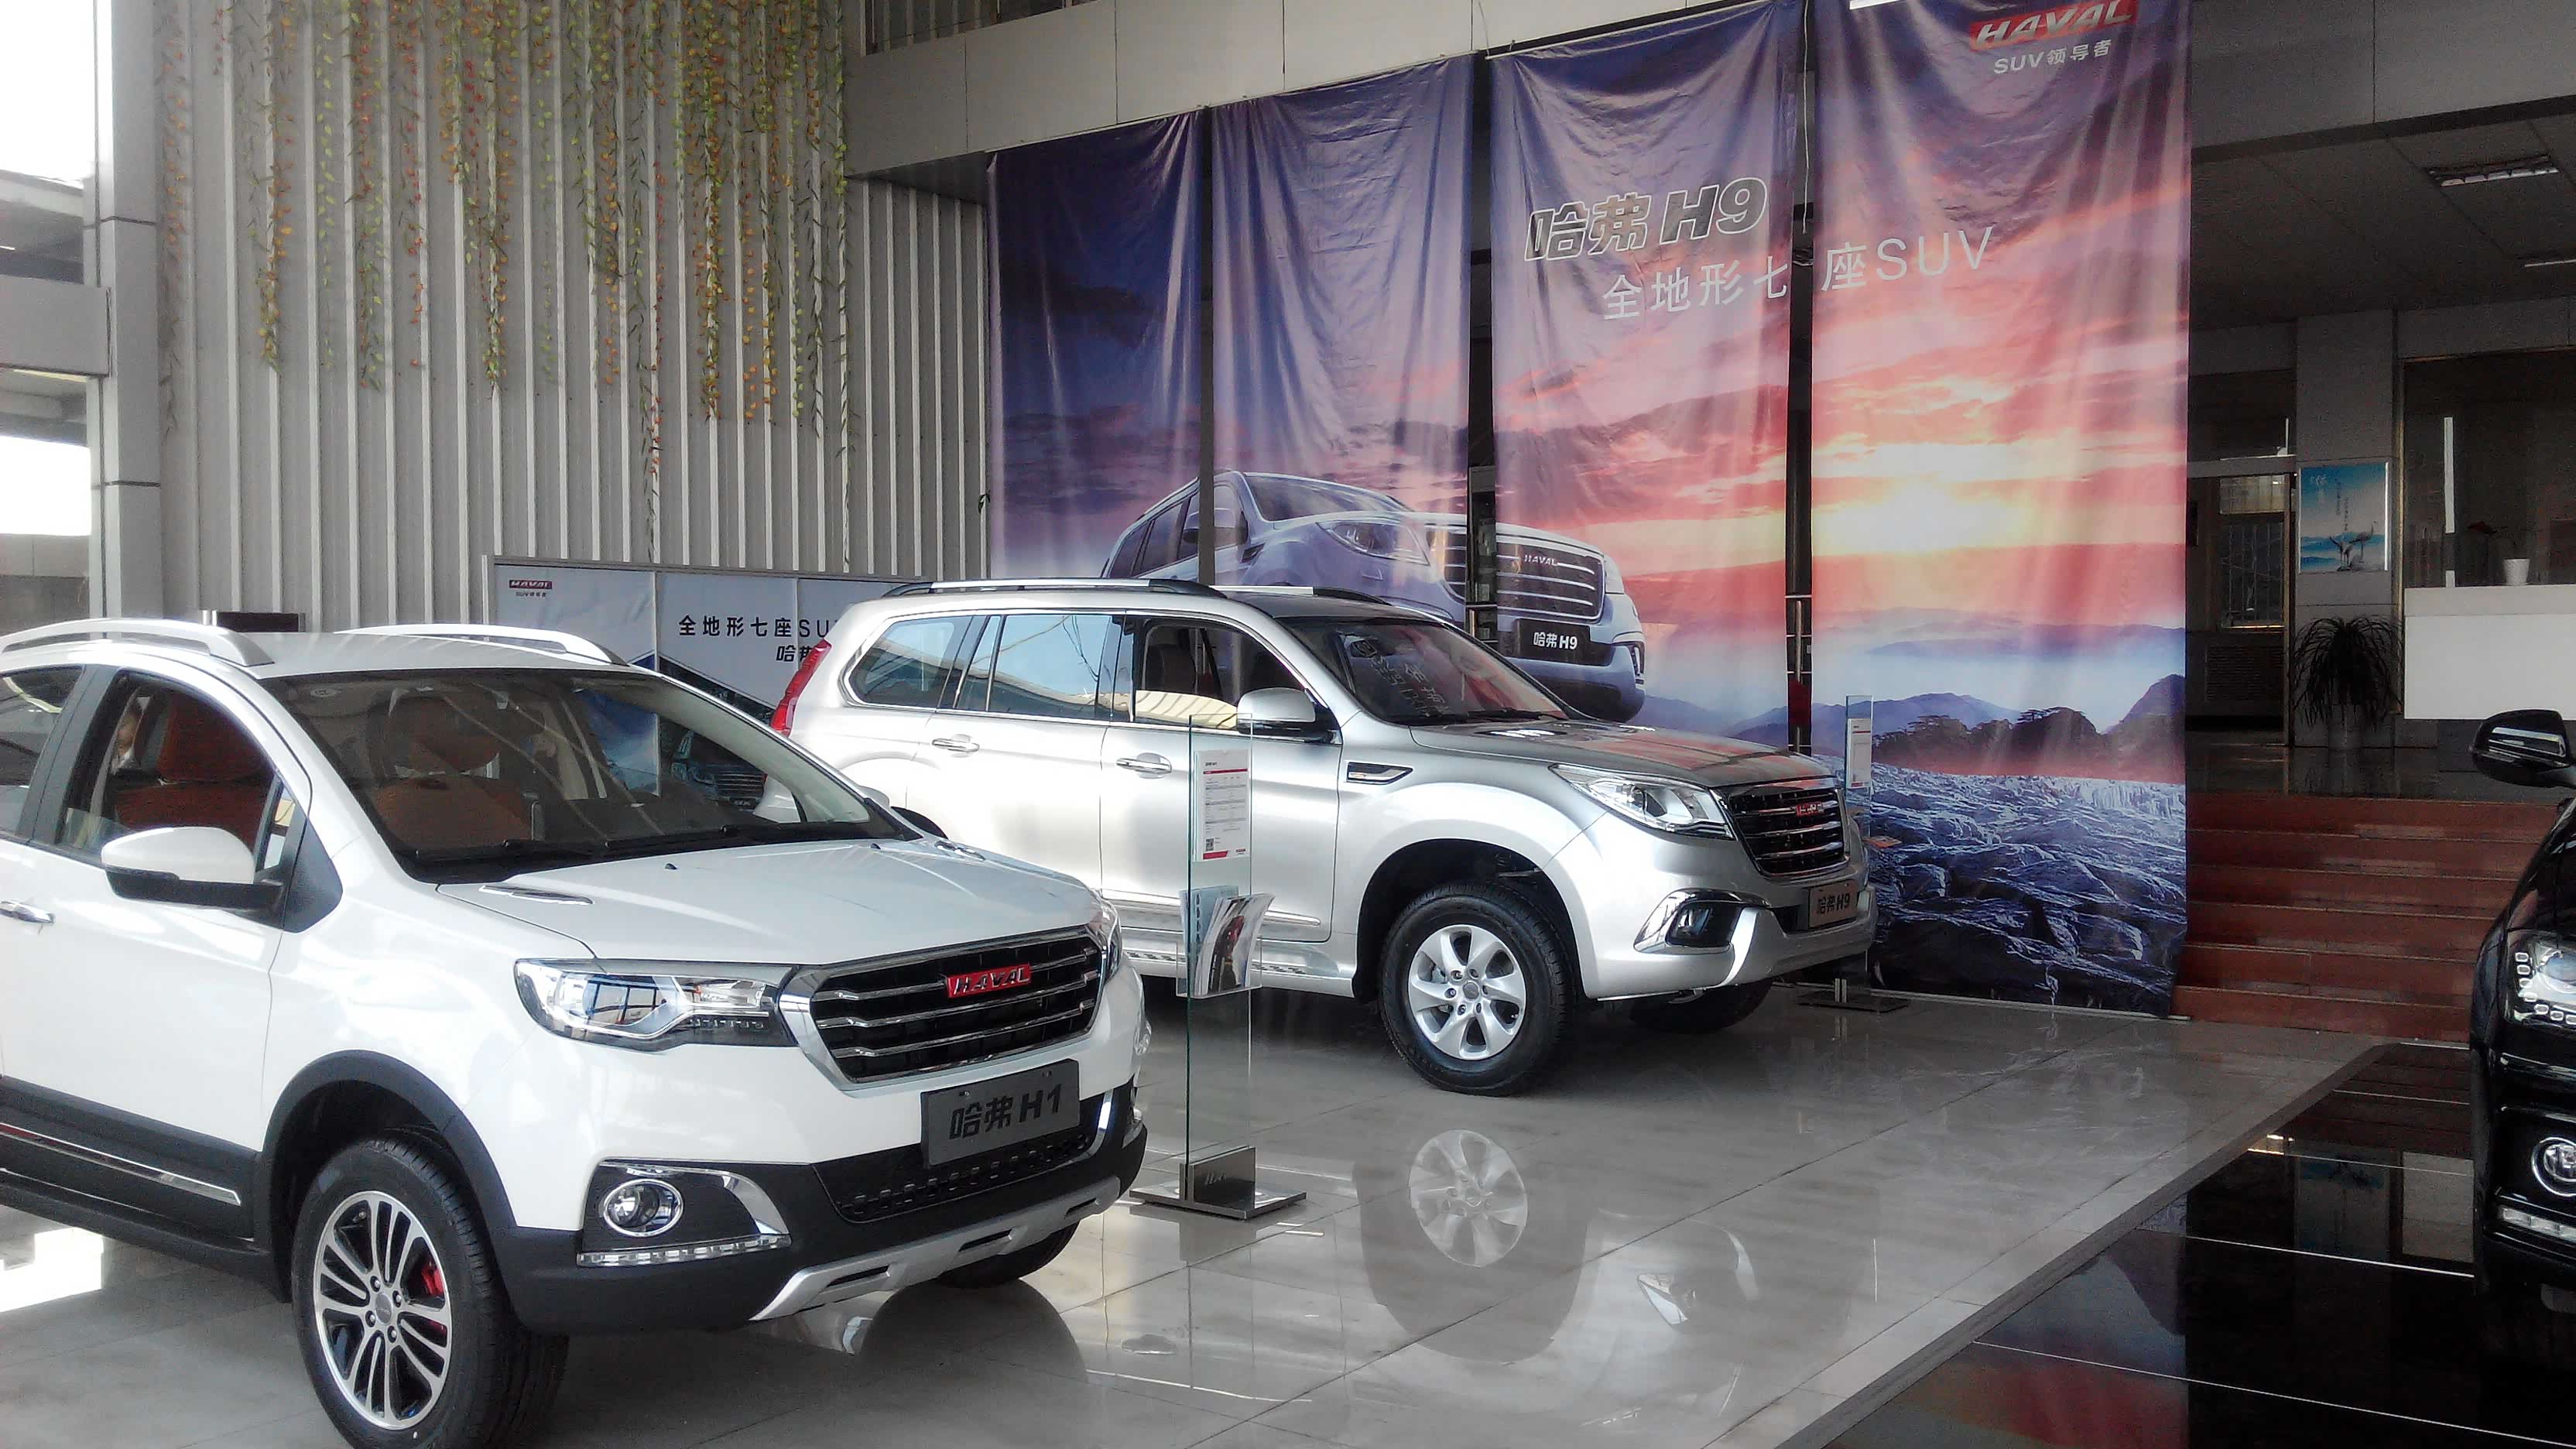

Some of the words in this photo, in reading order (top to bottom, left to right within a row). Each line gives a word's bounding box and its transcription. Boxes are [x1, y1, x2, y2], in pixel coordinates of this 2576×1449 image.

[1975, 0, 2132, 46] HAVAL
[1993, 39, 2112, 74] SUV领导者
[1524, 192, 1652, 262] 哈弗
[1659, 176, 1768, 245] H9
[679, 615, 838, 638] 全地形七座SU
[1533, 632, 1557, 648] 哈弗
[1559, 635, 1577, 649] H9
[954, 968, 1031, 995] HAVAL
[949, 1095, 1013, 1139] 哈弗
[1019, 1084, 1062, 1122] H1
